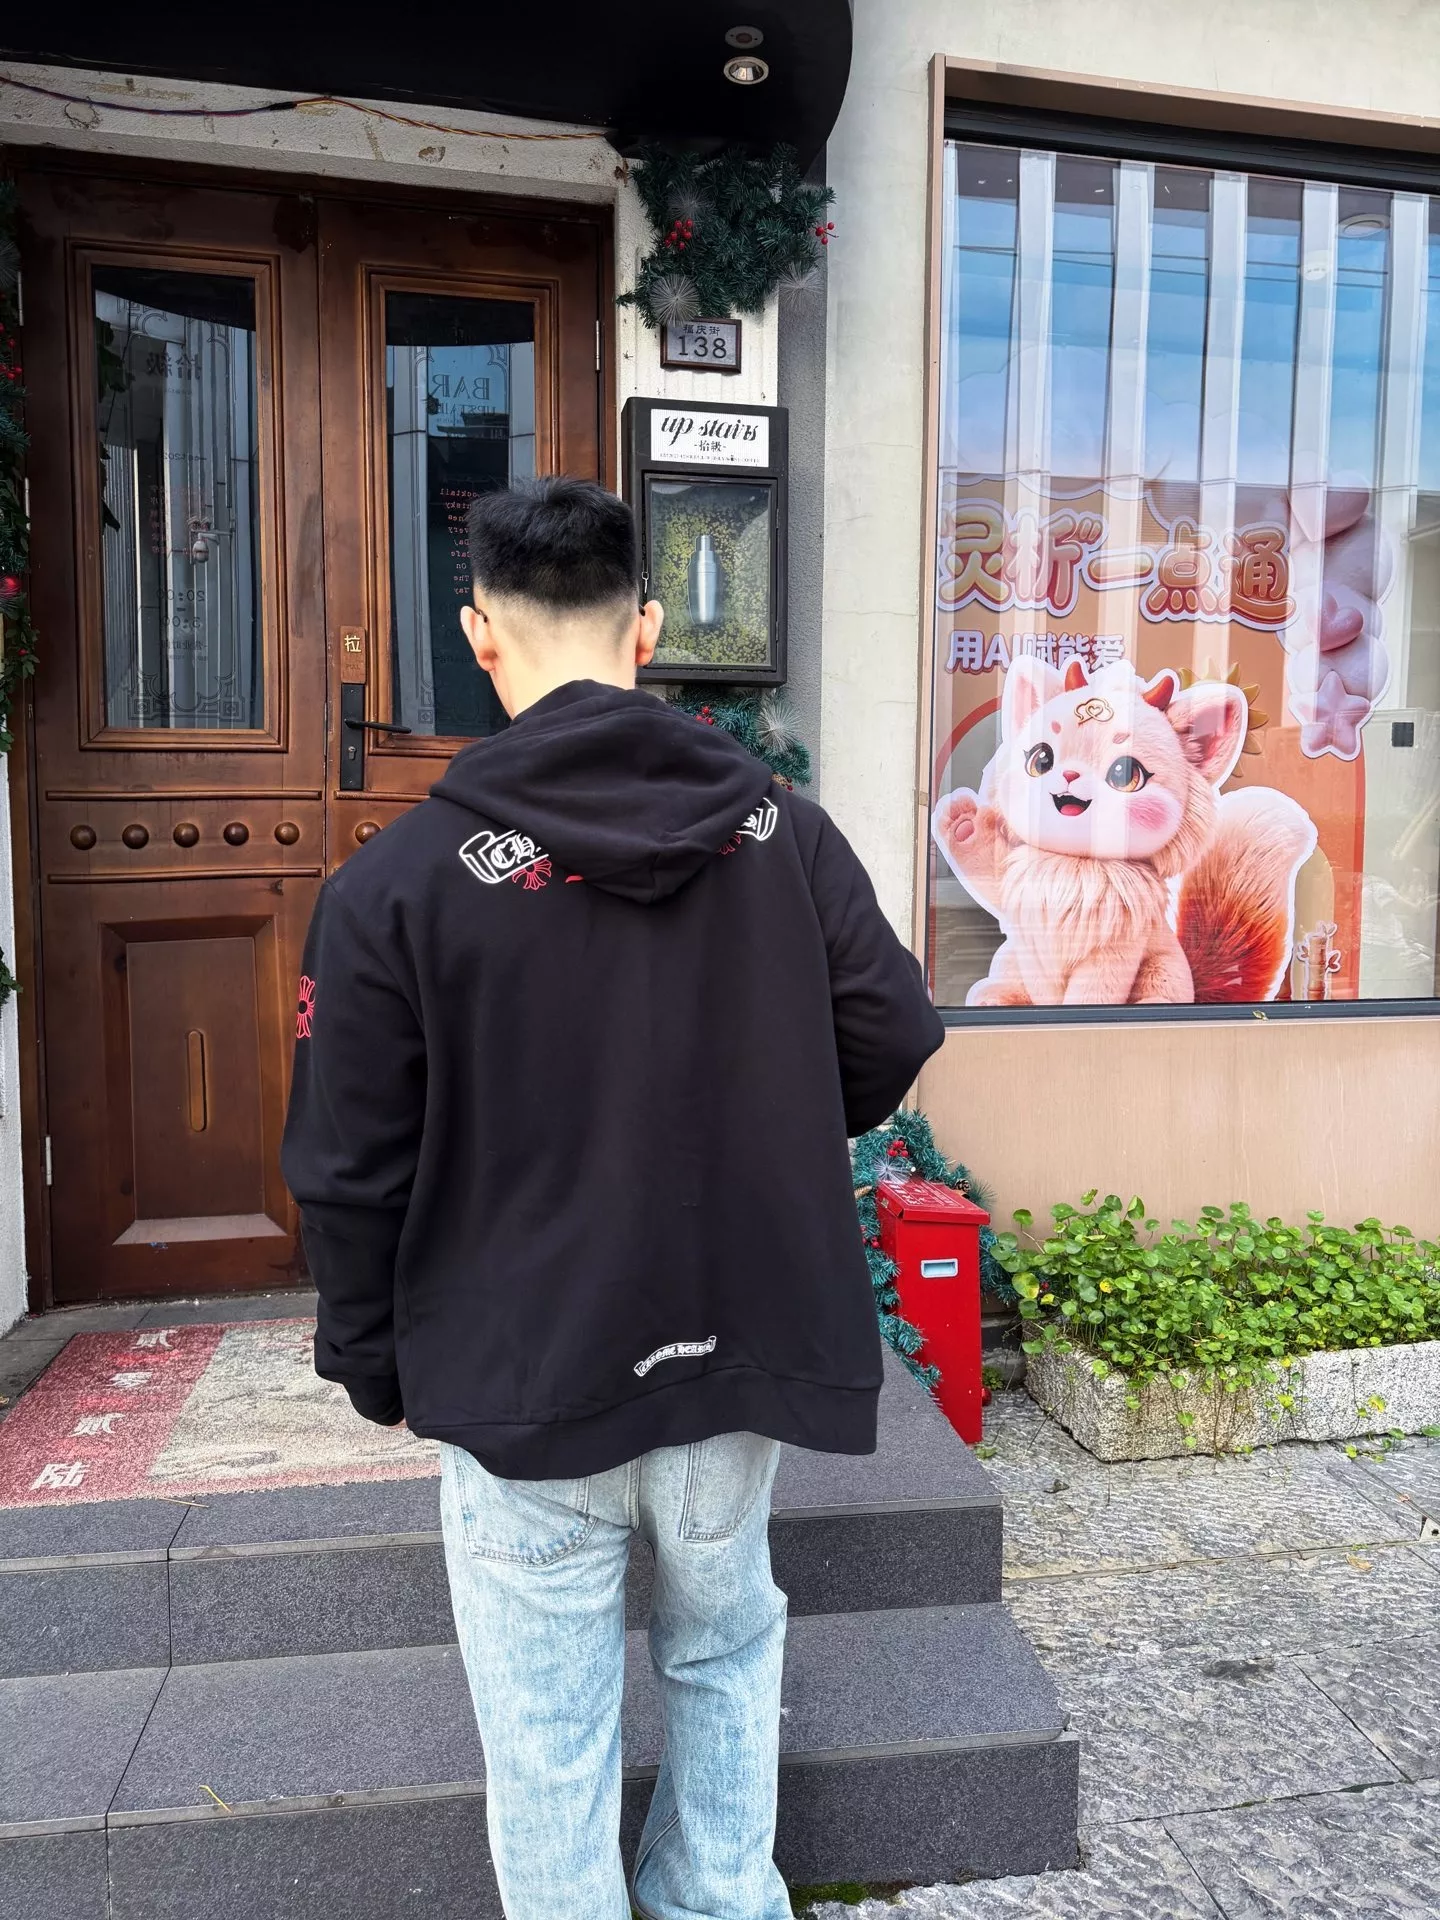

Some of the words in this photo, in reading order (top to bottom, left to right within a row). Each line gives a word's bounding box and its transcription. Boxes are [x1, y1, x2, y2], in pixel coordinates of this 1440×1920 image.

[678, 335, 727, 359] 138
[660, 416, 694, 446] up
[698, 419, 759, 441] stairs
[344, 635, 361, 652] 拉
